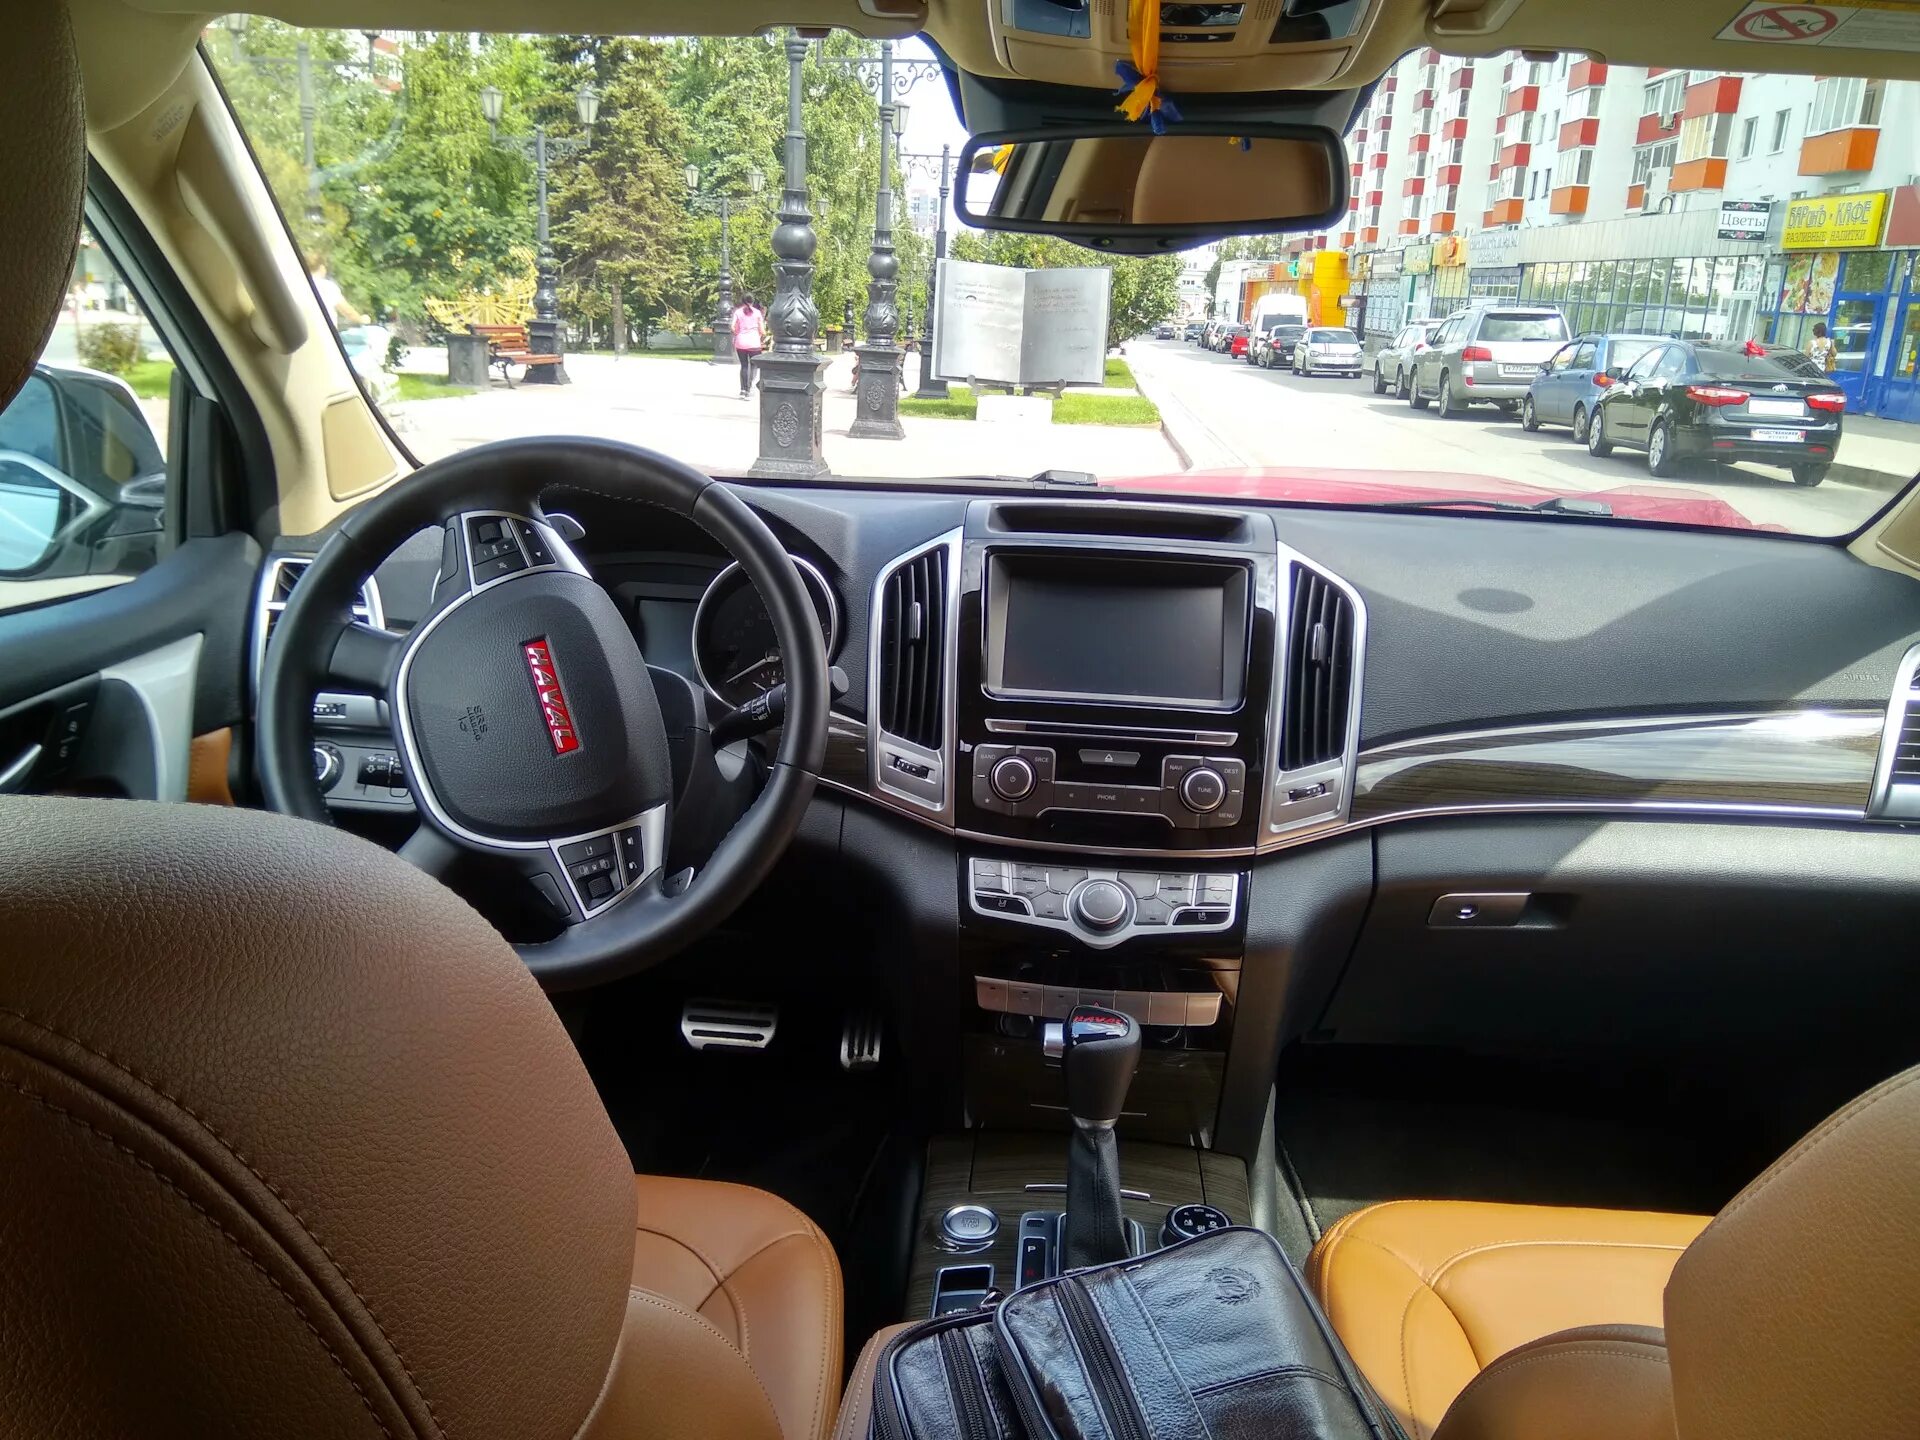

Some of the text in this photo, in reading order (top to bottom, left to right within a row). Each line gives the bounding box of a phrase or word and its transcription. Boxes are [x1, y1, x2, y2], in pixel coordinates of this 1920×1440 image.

[1834, 200, 1872, 227] КАФЕ
[1721, 213, 1767, 229] Цветы
[527, 646, 573, 749] HAVAL
[1197, 786, 1212, 794] TUNE
[1218, 811, 1235, 819] MENU
[1073, 1015, 1123, 1025] HAVAL
[1027, 1245, 1037, 1253] P
